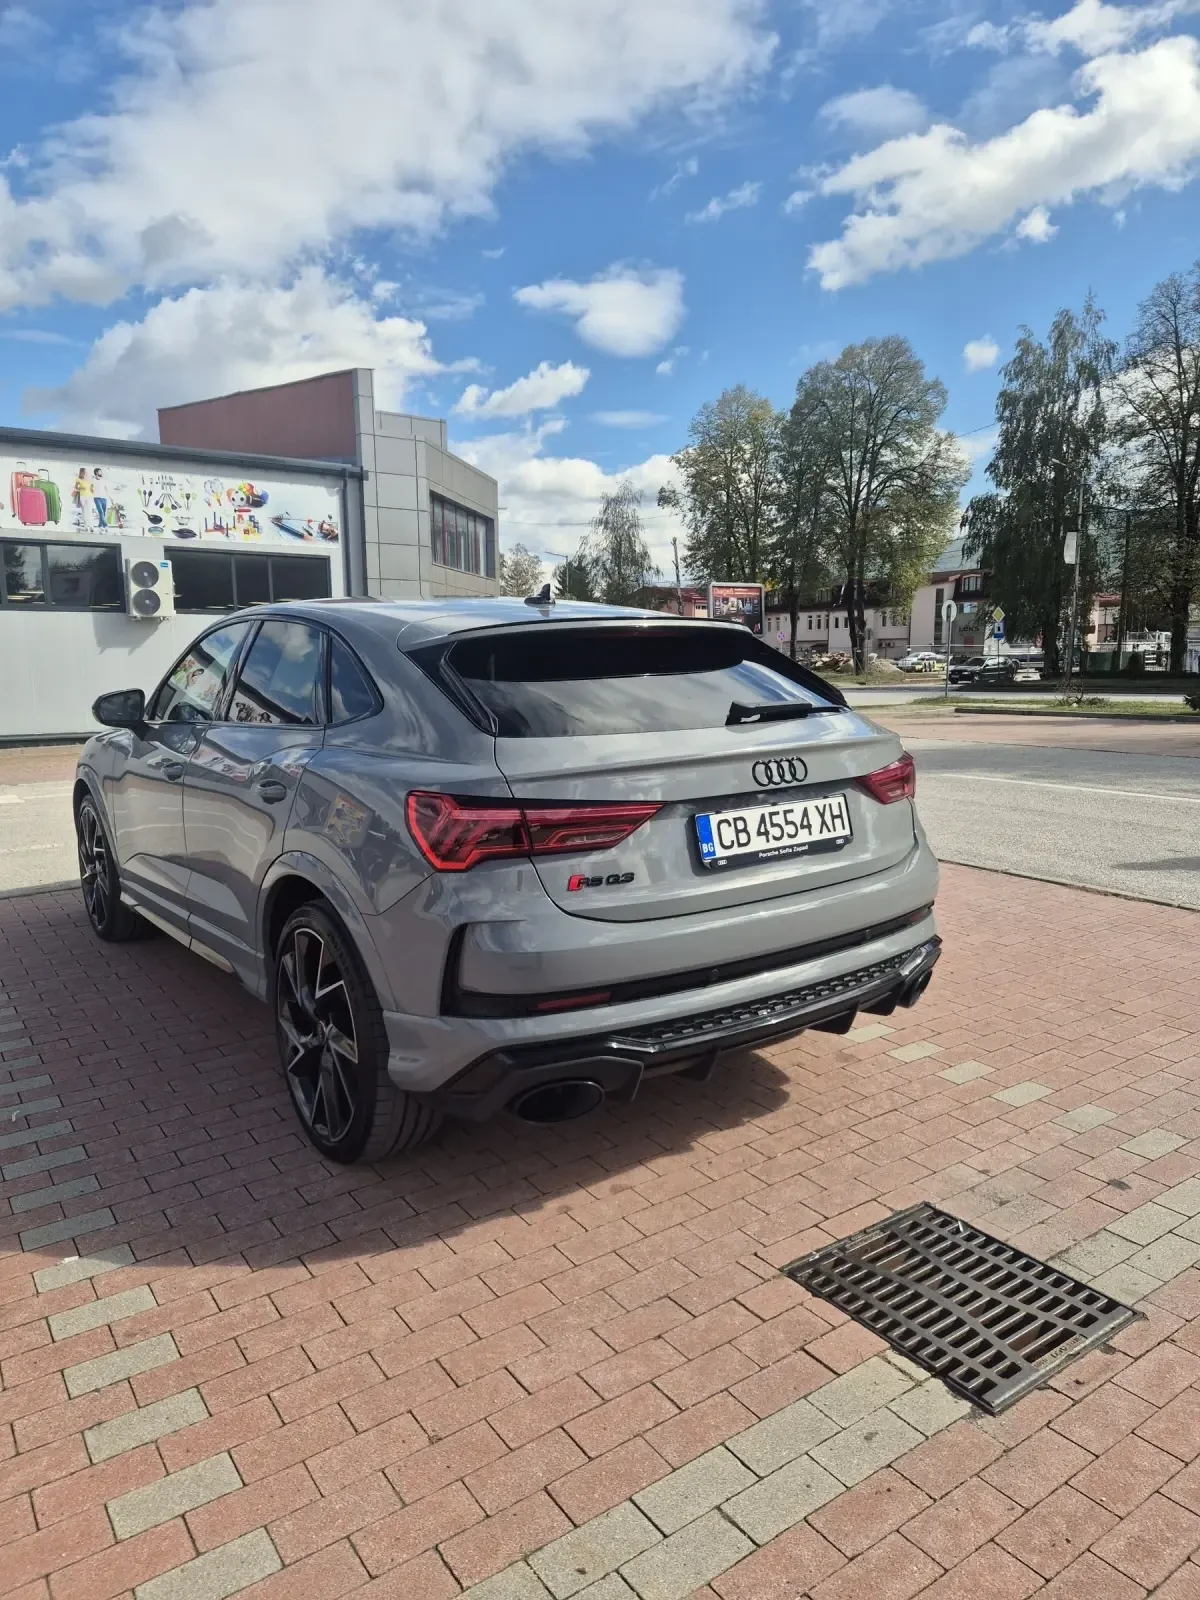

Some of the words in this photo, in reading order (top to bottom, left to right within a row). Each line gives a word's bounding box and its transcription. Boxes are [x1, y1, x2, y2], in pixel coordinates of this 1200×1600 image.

[716, 816, 751, 850] CB
[756, 807, 812, 843] 4554
[814, 802, 846, 834] XH
[702, 842, 714, 853] BG
[758, 850, 778, 858] Porsche
[780, 846, 792, 854] Sofia
[567, 874, 604, 892] RS
[605, 872, 635, 886] Q3
